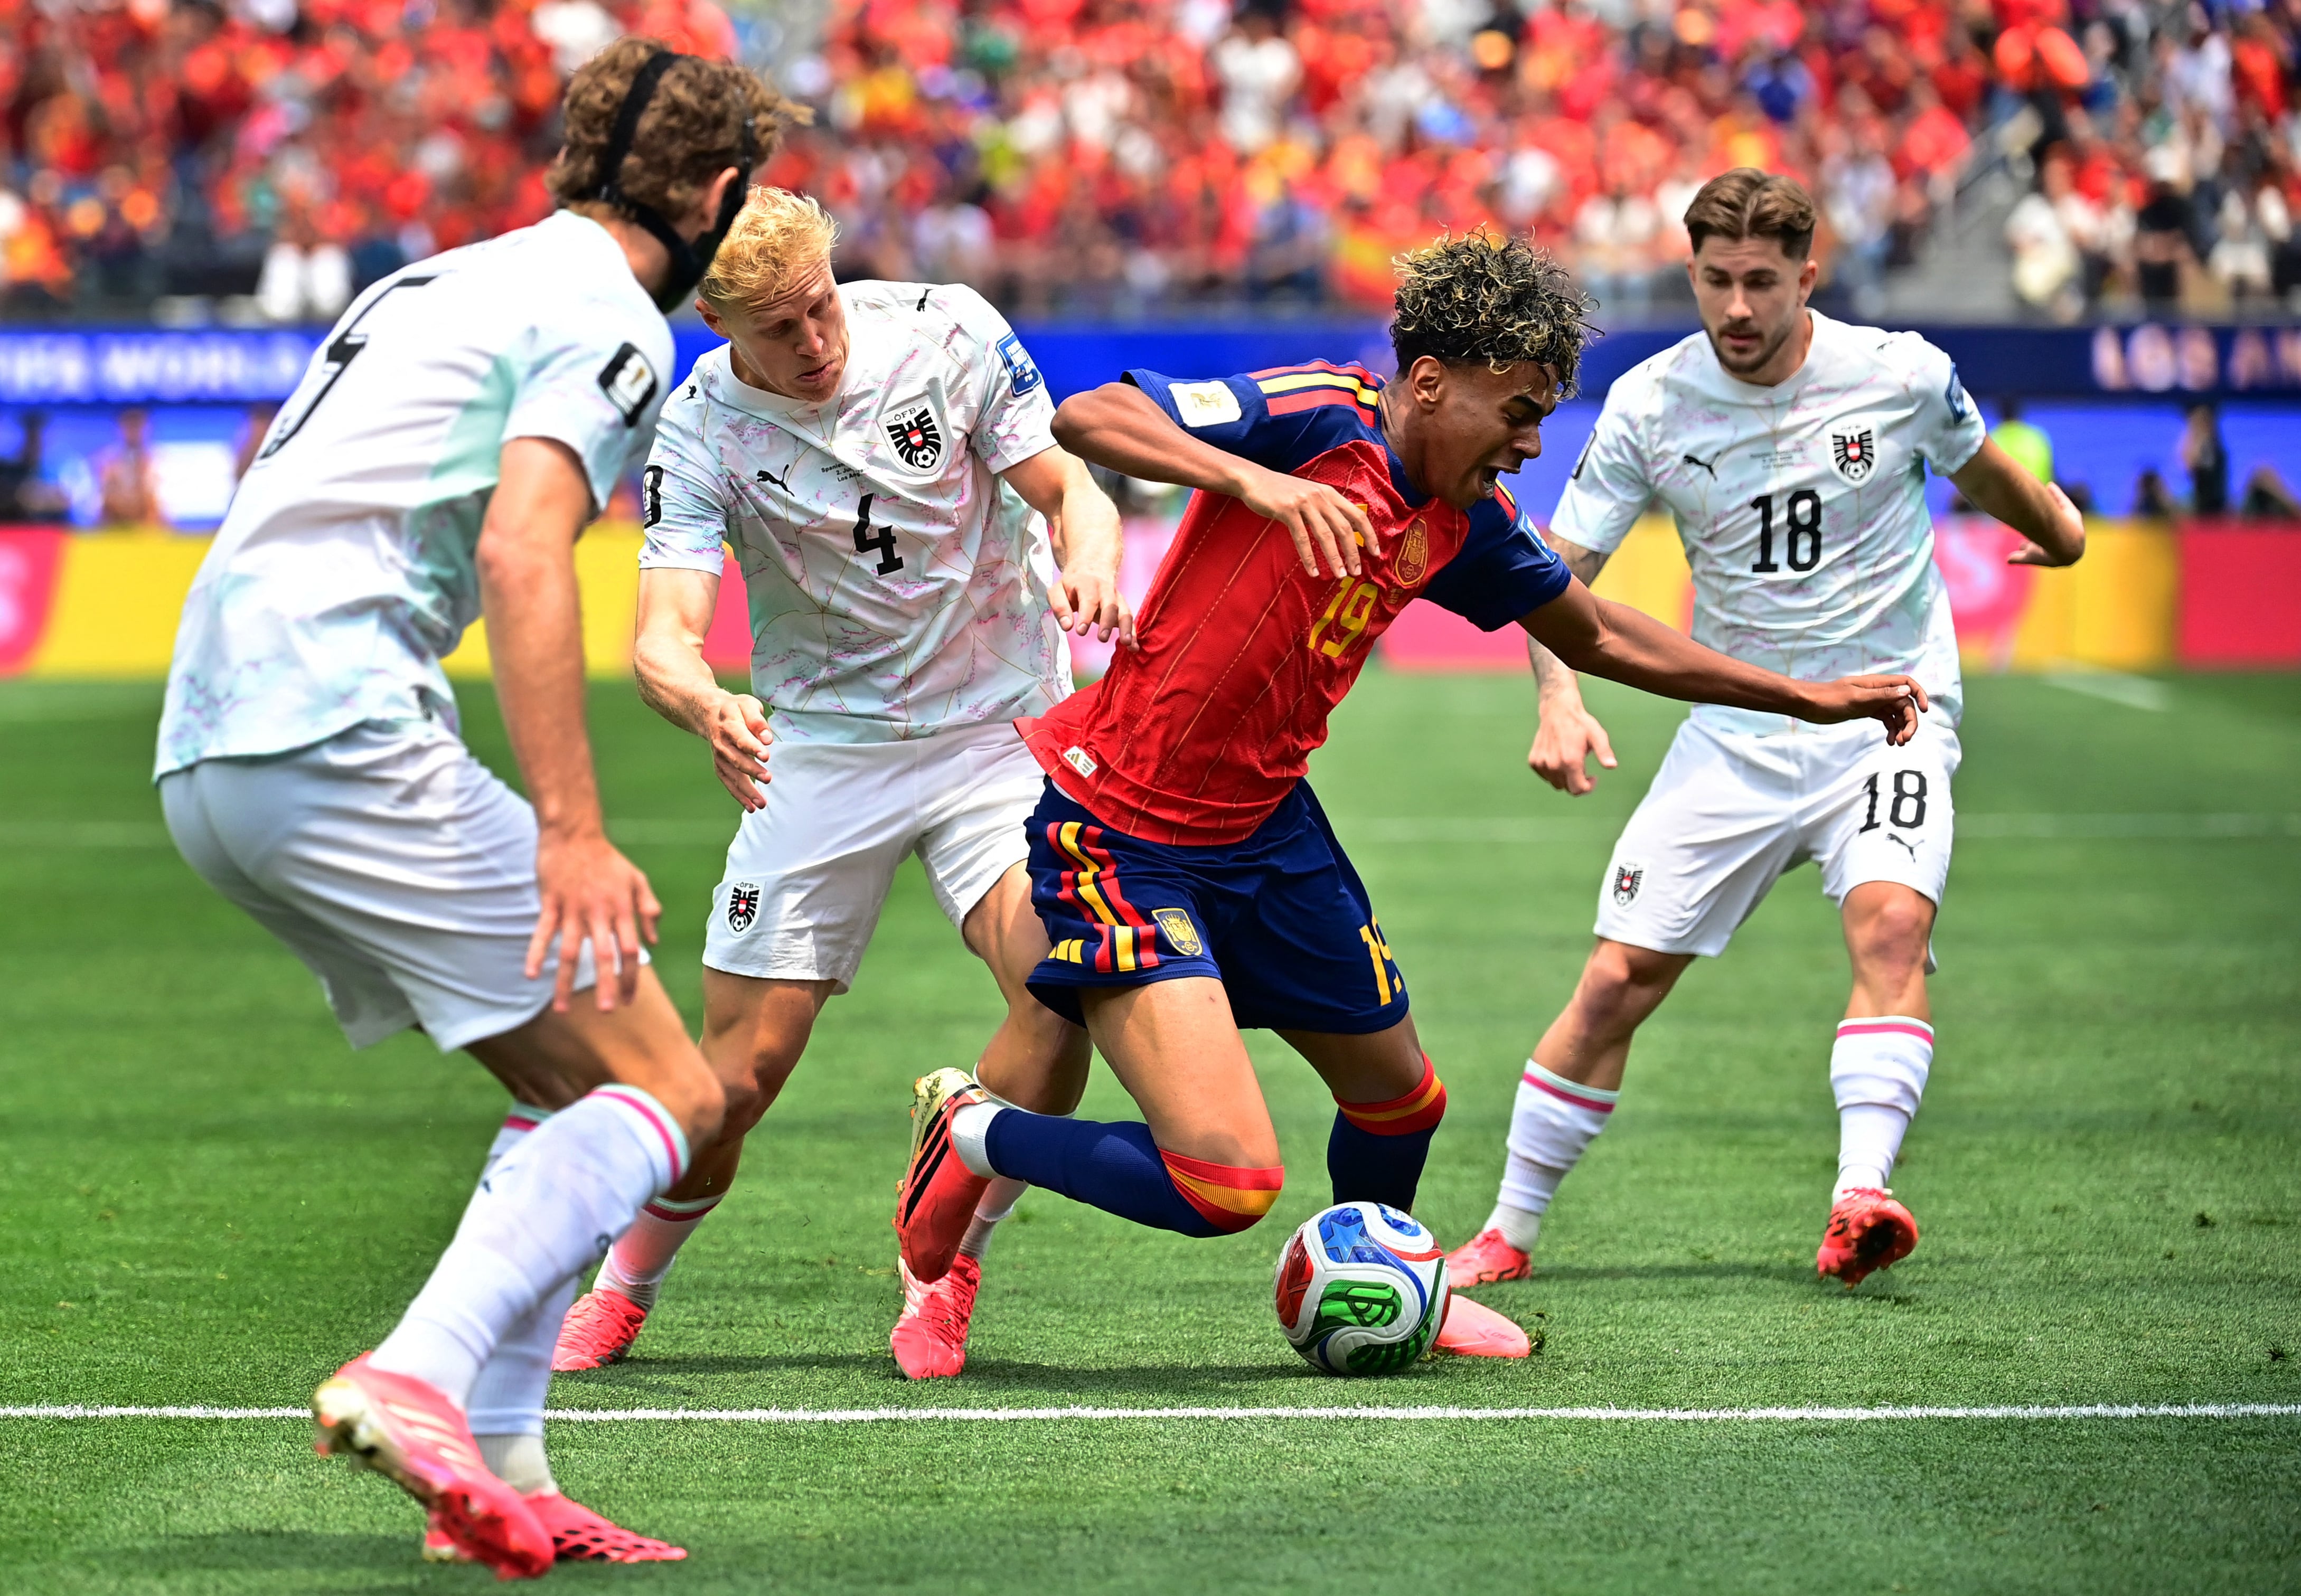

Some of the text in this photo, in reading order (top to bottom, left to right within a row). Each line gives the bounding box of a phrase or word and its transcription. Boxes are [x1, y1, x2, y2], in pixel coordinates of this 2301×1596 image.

[852, 493, 904, 576] 4
[1750, 489, 1822, 573] 18
[1307, 576, 1378, 658] 19
[1858, 769, 1928, 834] 18
